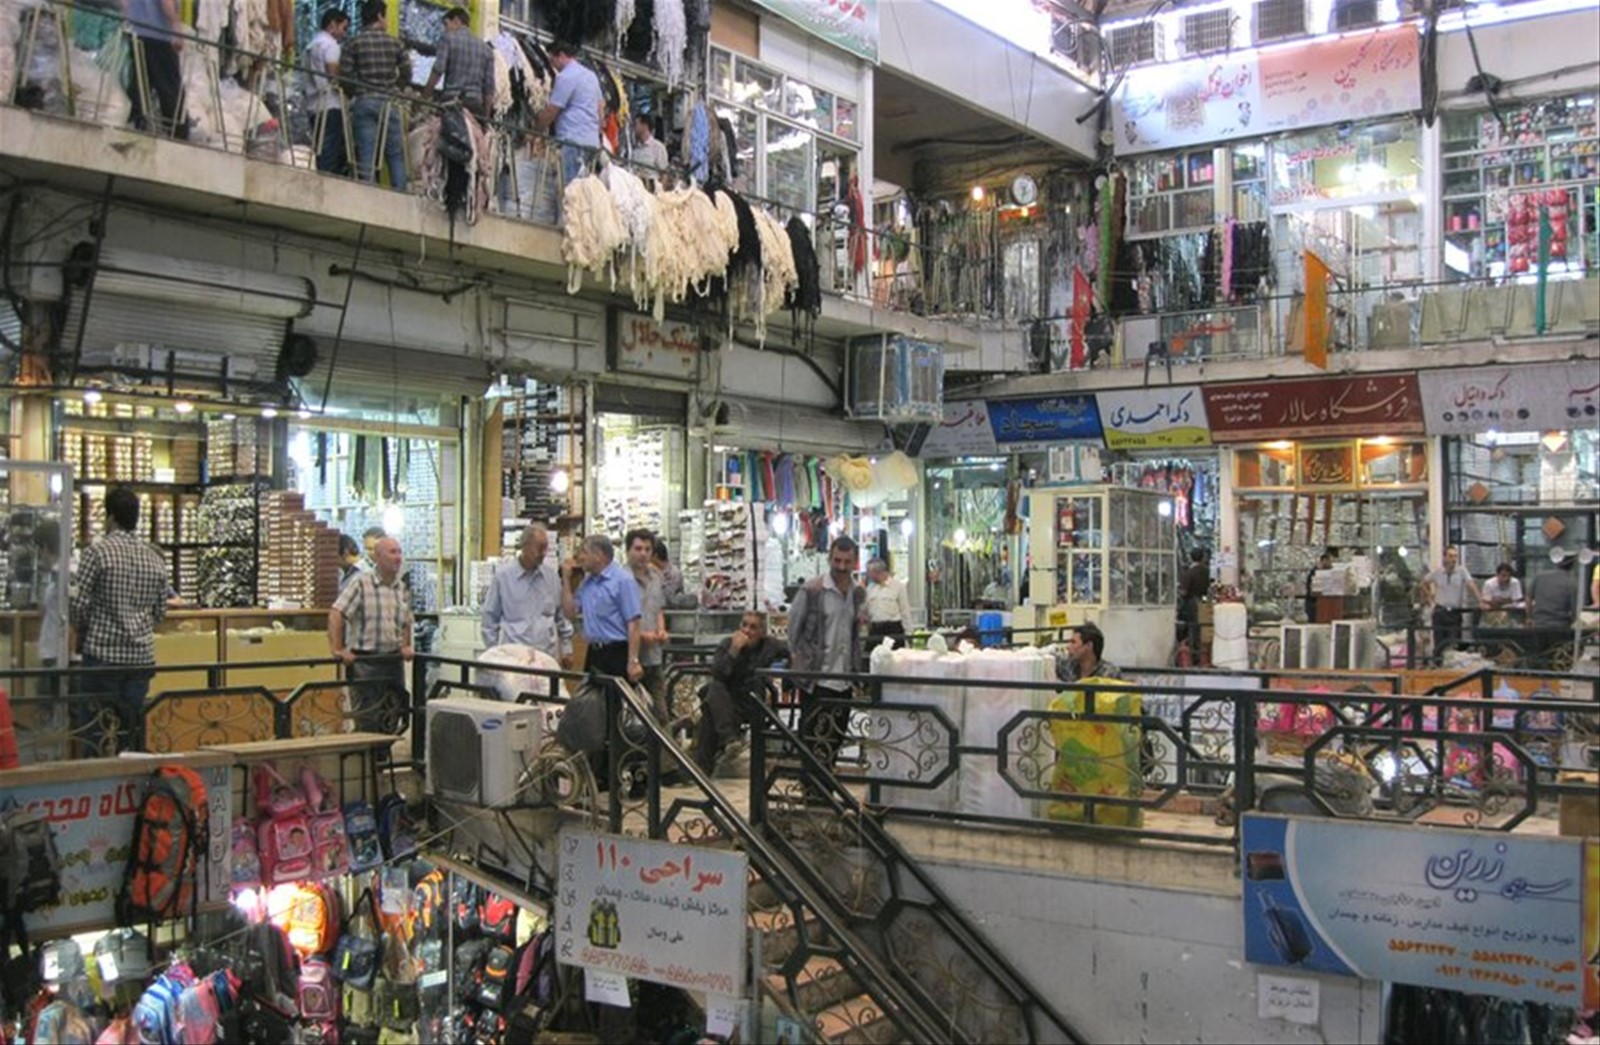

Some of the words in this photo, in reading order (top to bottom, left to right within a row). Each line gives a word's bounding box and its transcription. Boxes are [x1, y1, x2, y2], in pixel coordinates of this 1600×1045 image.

[1110, 402, 1171, 428] احمدی
[1169, 390, 1194, 424] دکمه
[1279, 395, 1317, 425] سالار
[1319, 377, 1409, 423] فروشگاه
[999, 408, 1058, 438] سجاد
[596, 841, 632, 872] ۱۱۰
[1425, 841, 1508, 903] زرین
[639, 855, 723, 892] سراجی
